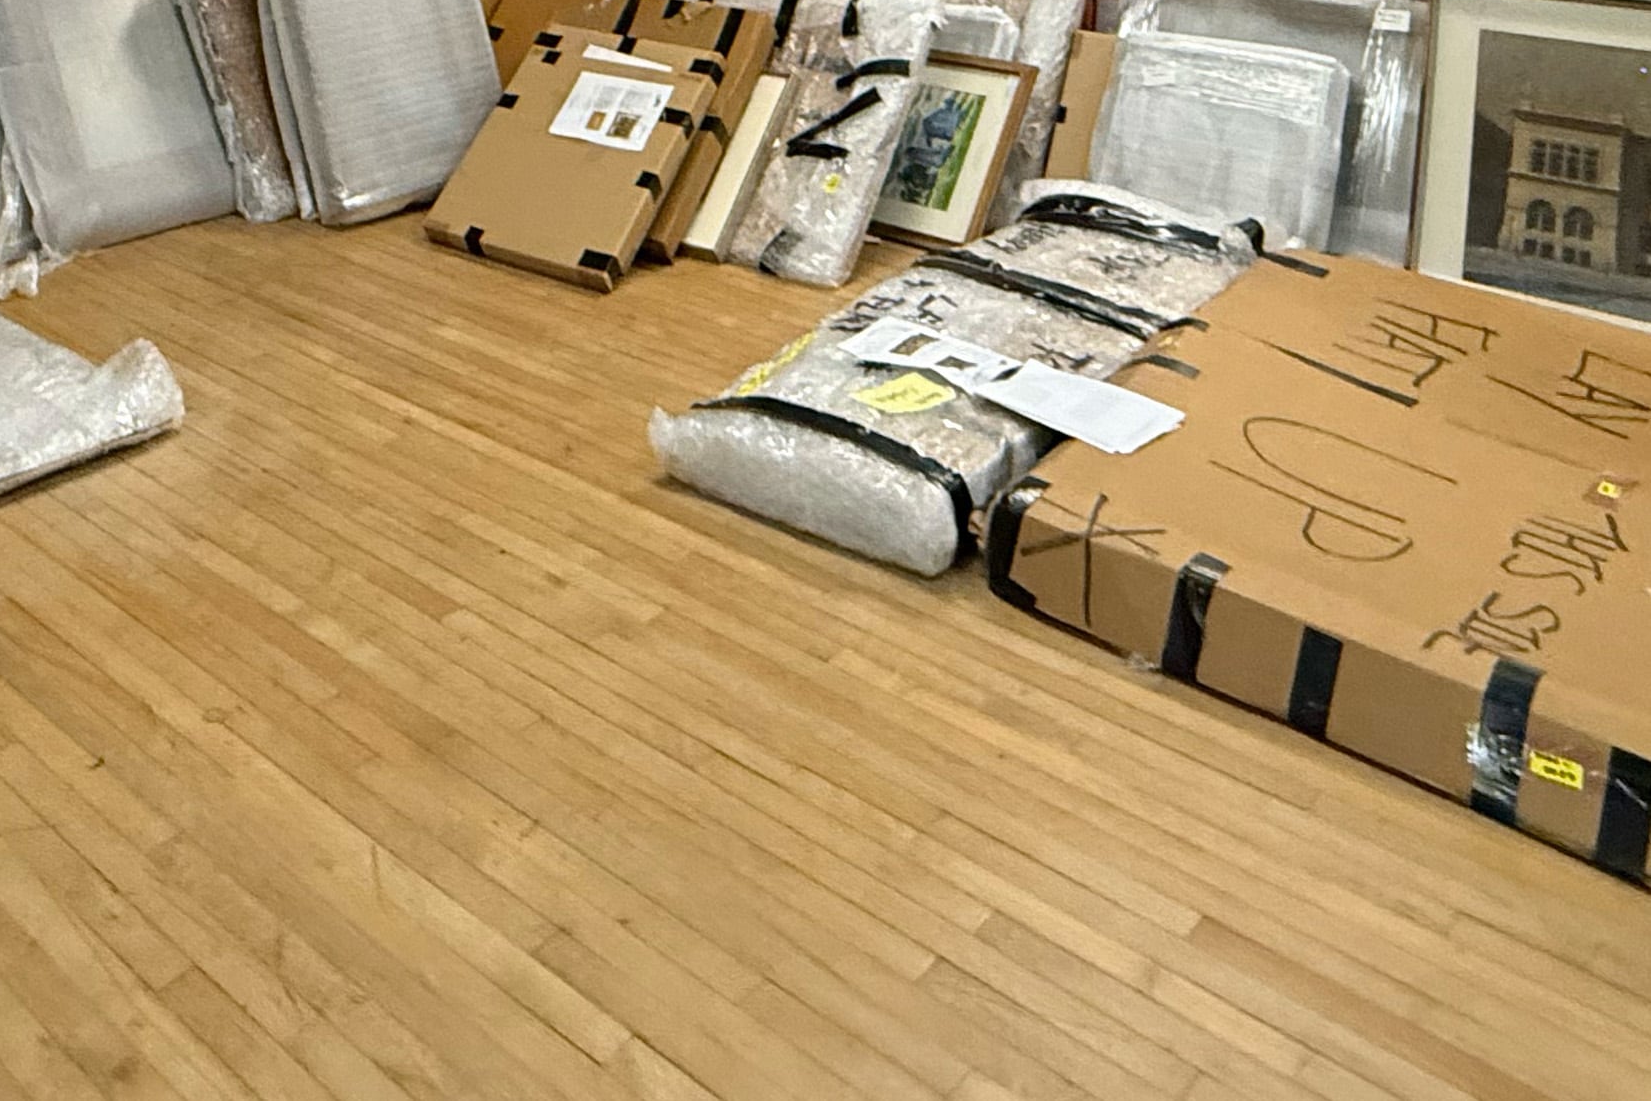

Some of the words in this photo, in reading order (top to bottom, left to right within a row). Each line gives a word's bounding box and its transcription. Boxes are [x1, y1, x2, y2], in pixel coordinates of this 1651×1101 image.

[1486, 349, 1651, 440] LAY
[1210, 415, 1459, 563] UP
[1499, 512, 1630, 596] THIS
